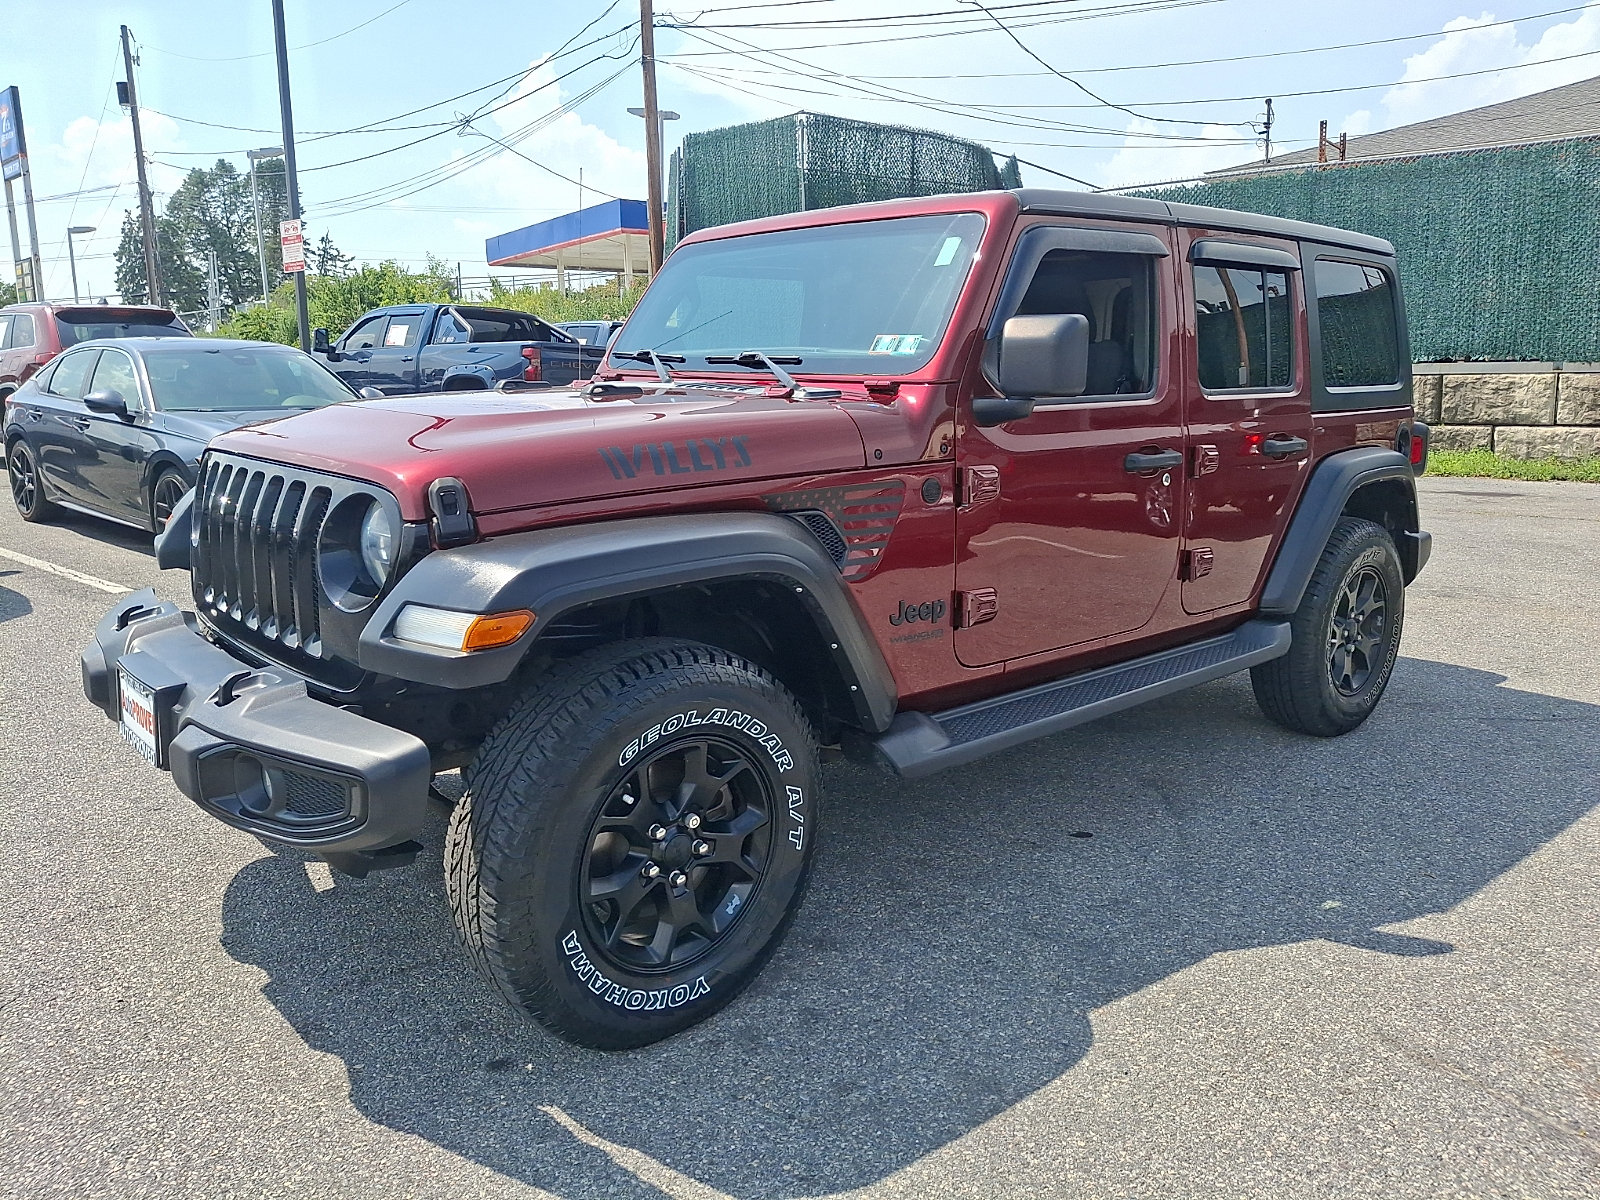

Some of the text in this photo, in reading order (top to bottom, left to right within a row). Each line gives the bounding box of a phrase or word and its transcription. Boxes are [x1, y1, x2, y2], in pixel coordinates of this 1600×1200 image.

[598, 435, 752, 480] WILLYS
[889, 599, 946, 627] Jeep
[618, 708, 805, 851] GEOLANDAR A/T
[562, 929, 711, 1011] YOKOHAMA
